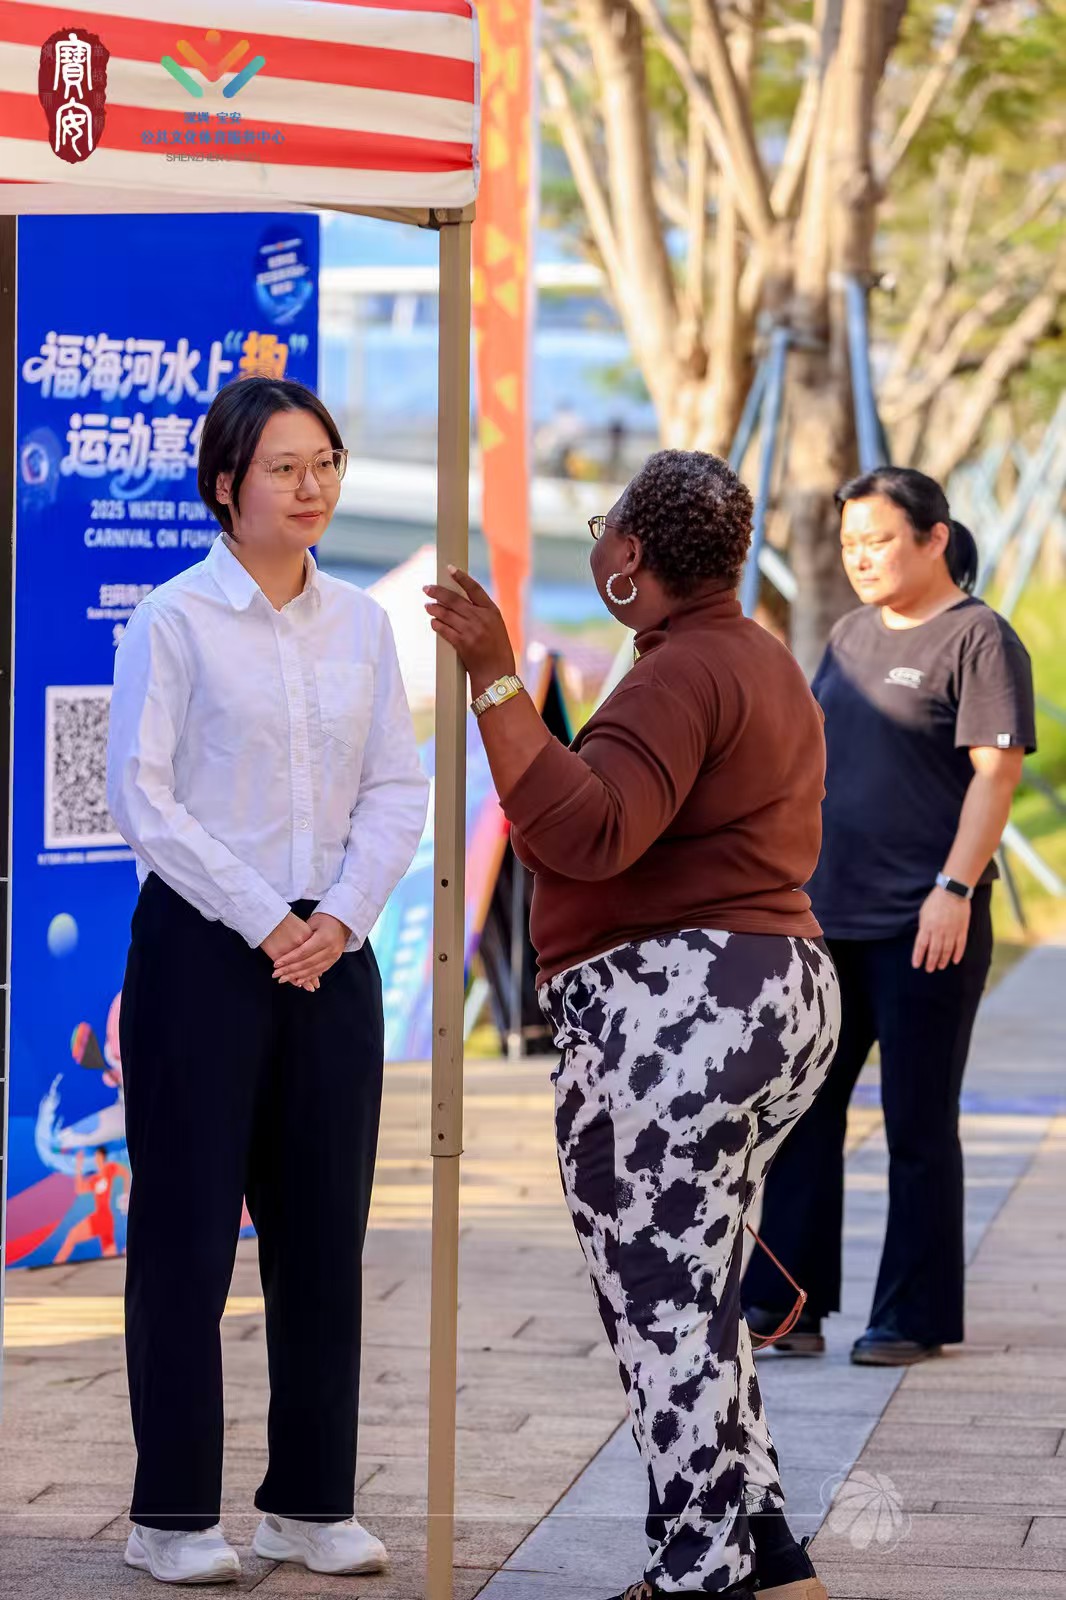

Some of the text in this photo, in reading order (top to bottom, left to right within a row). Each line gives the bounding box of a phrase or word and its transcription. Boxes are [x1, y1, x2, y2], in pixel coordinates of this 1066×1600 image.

[128, 501, 176, 520] WATER
[84, 527, 154, 548] CARNIVAL
[156, 528, 179, 548] ON
